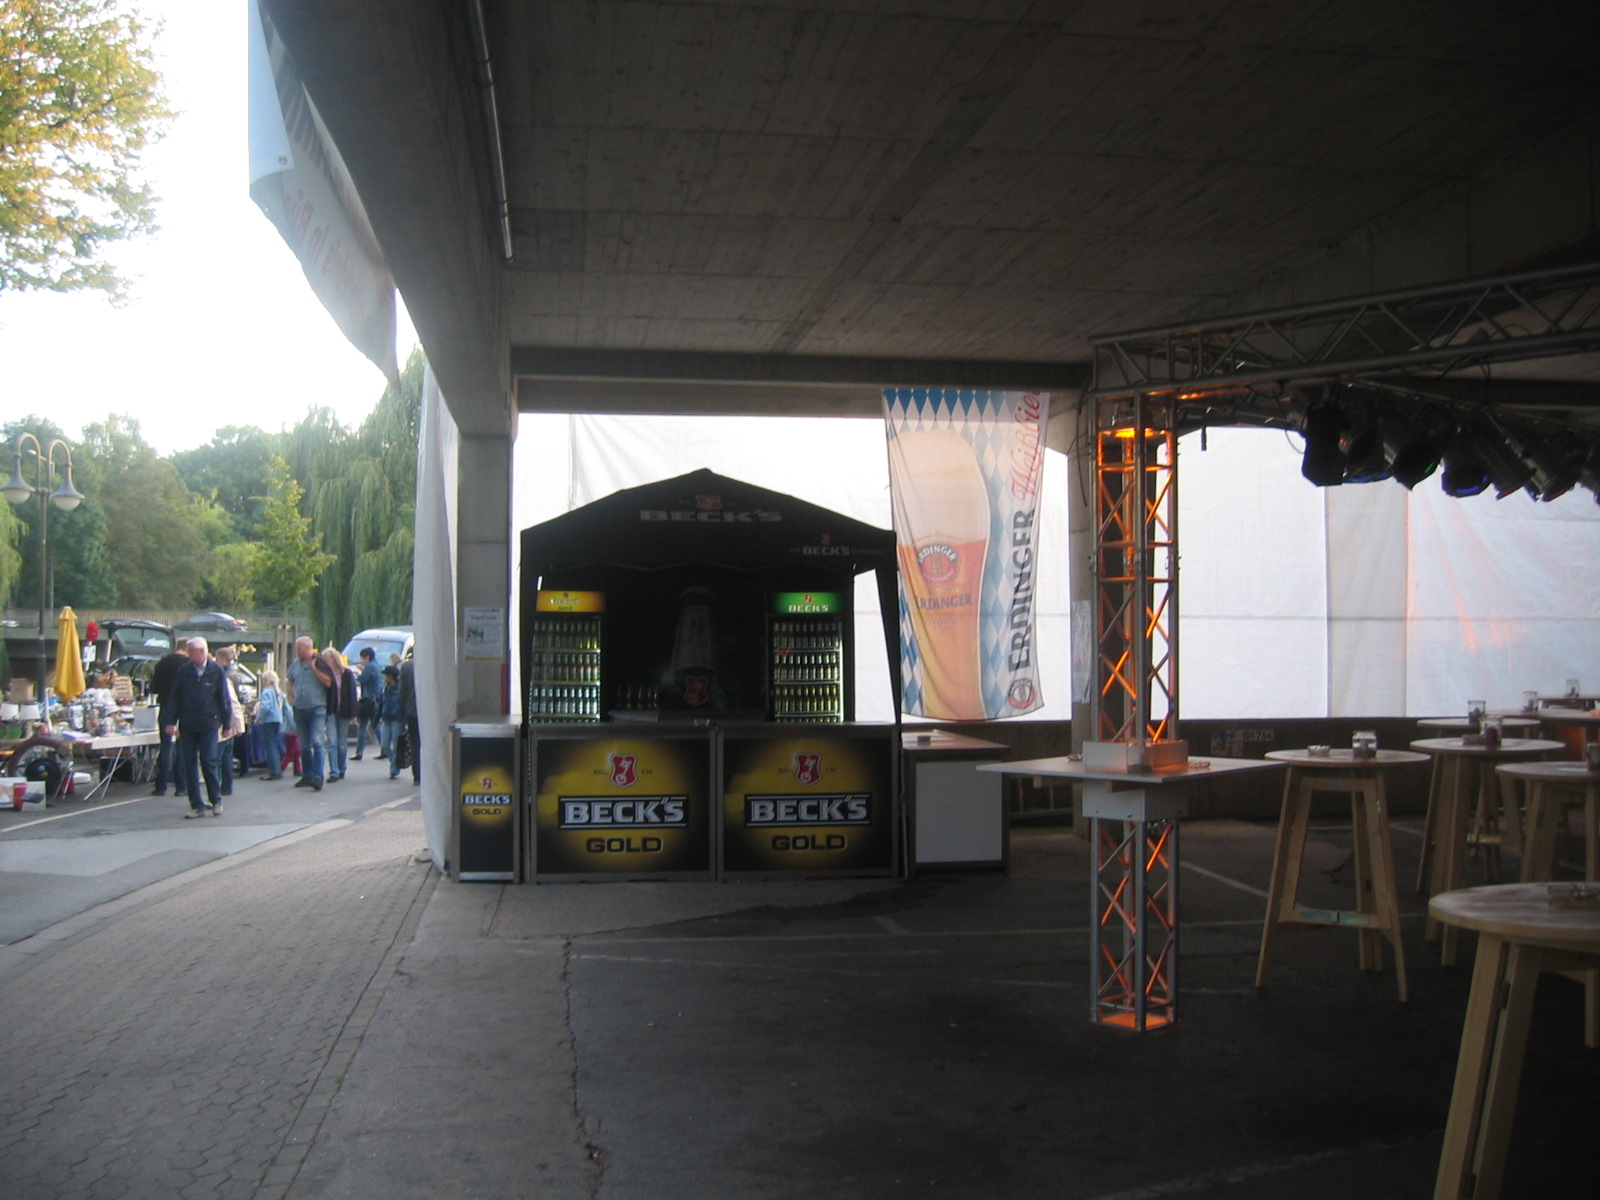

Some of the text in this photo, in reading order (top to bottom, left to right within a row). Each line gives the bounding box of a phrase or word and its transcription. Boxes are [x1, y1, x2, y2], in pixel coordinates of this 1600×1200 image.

[640, 509, 783, 523] BECK'S
[802, 545, 850, 556] BECK'S
[1007, 508, 1035, 673] ERDINGER
[788, 603, 829, 612] BECK'S
[918, 592, 973, 611] RDINGER
[464, 794, 510, 804] BECK'S
[563, 796, 686, 824] BECK'S
[750, 794, 869, 823] BECK'S
[585, 835, 664, 853] GOLD
[771, 833, 847, 852] GOLD
